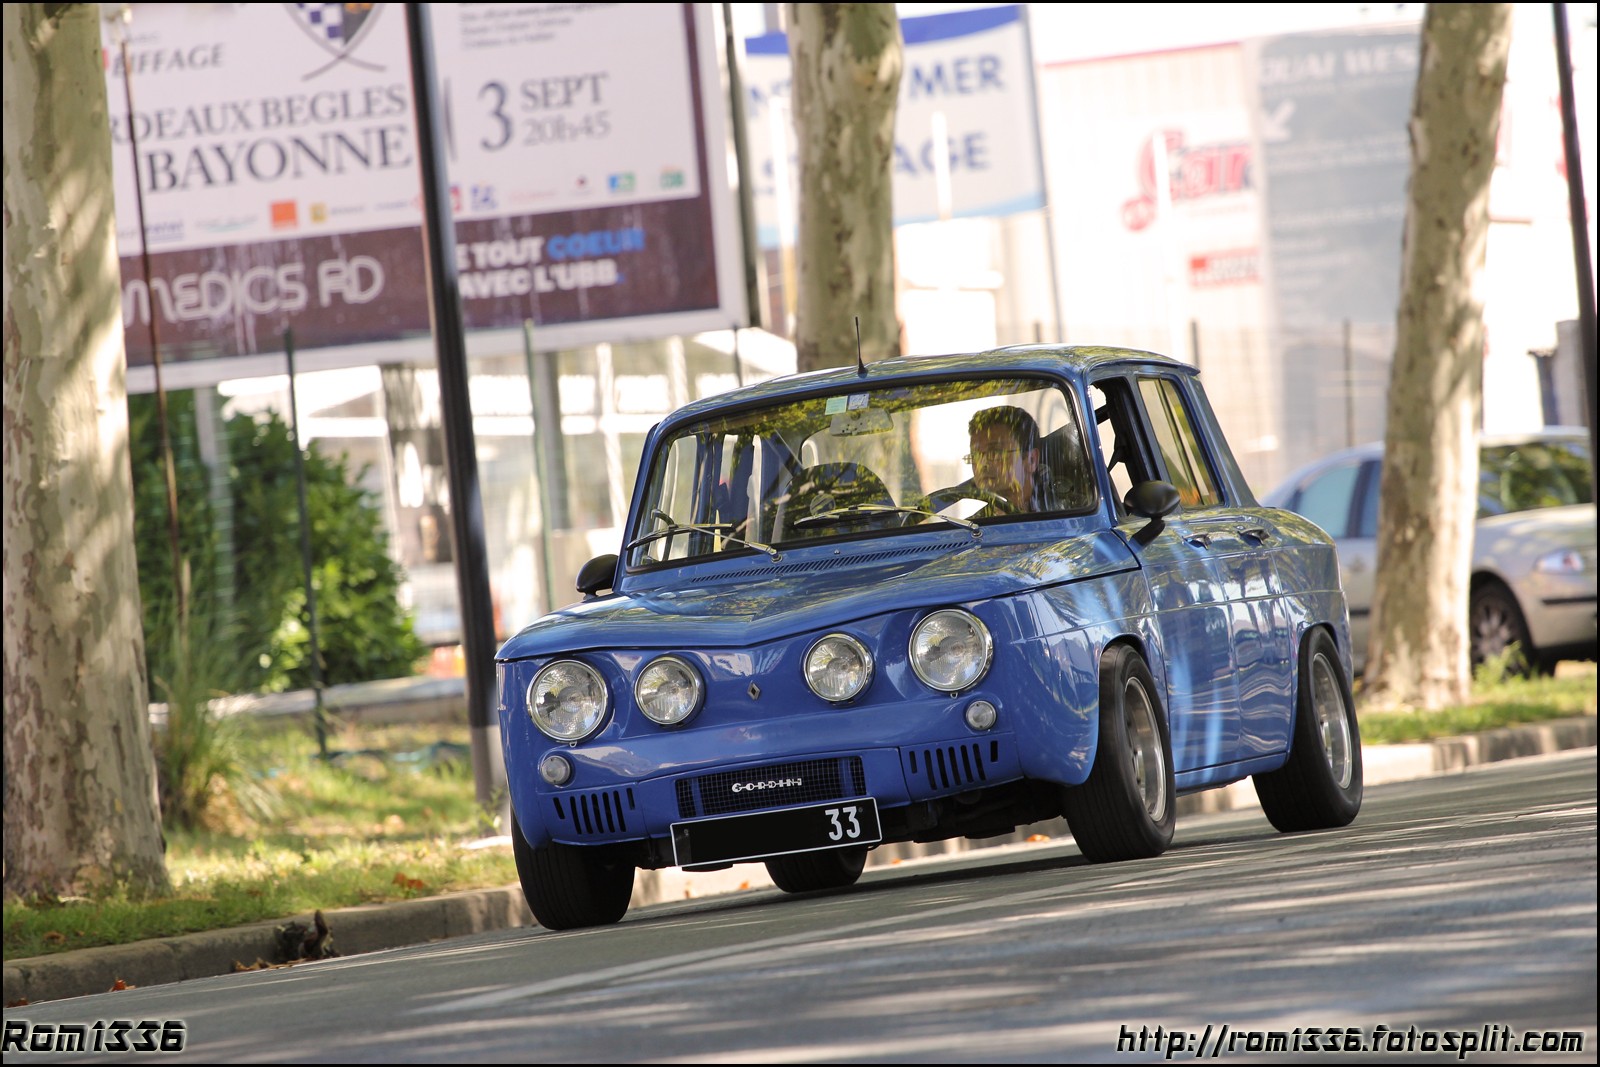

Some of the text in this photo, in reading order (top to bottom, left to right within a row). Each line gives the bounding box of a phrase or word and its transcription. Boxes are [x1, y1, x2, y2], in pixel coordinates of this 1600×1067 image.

[910, 54, 1005, 99] MER
[259, 83, 409, 128] BEGLES
[478, 71, 609, 152] 3 SEPT
[523, 110, 612, 147] 20h45
[145, 123, 413, 193] BAYONNE
[473, 236, 546, 268] TOUT
[546, 227, 647, 260] COEUR
[457, 267, 532, 300] AVEC
[731, 778, 802, 793] GORDINI
[825, 806, 862, 841] 33
